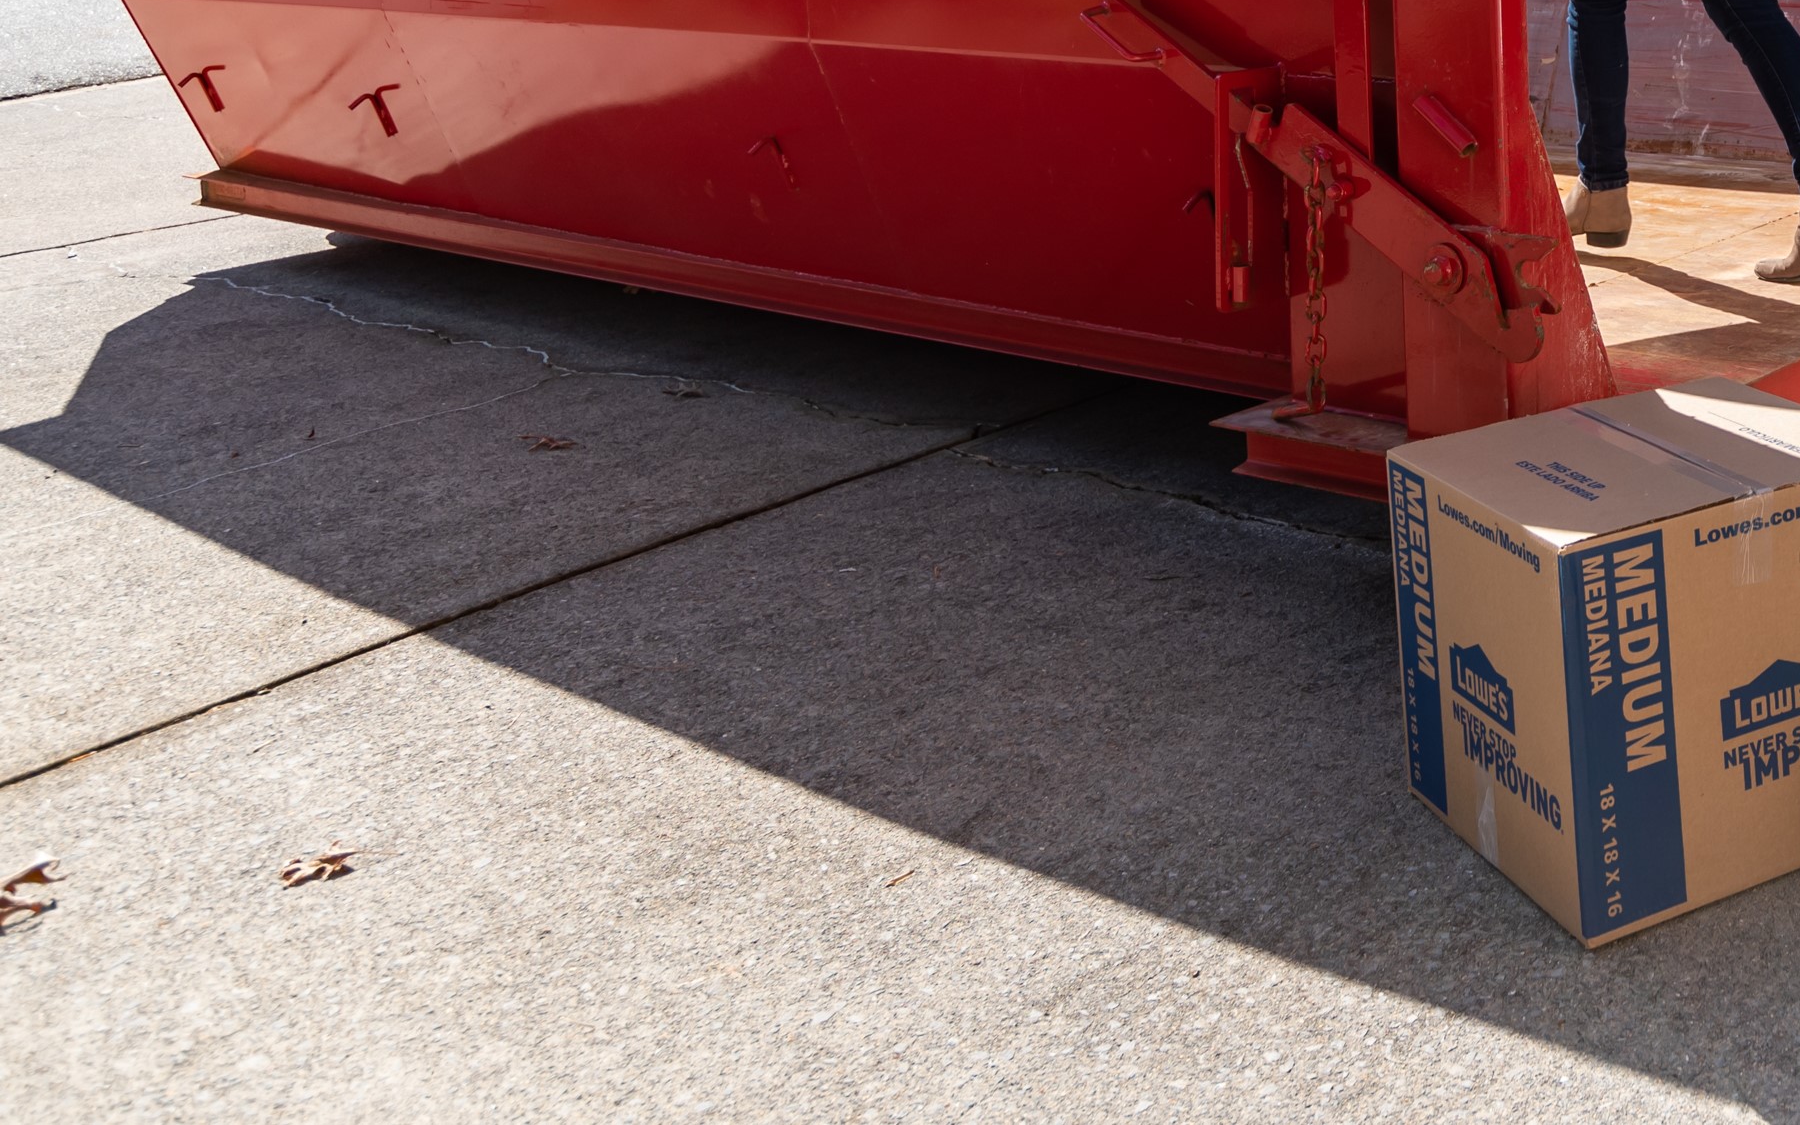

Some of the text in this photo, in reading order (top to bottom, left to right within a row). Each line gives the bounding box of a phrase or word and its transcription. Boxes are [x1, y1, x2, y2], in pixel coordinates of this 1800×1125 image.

[1515, 460, 1599, 501] ESTE LADO ARRIBA
[1546, 461, 1571, 473] THIS
[1565, 471, 1593, 483] SIDE
[1392, 469, 1410, 586] MEDIANA
[1404, 477, 1436, 681] MEDIUM
[1436, 494, 1541, 574] Lowes.com/Moving
[1581, 554, 1613, 697] MEDIANA
[1612, 541, 1668, 773] MEDIUM
[1407, 667, 1422, 782] 18 X 18 X 16
[1453, 700, 1517, 760] NEVER STOP
[1456, 655, 1509, 721] LOWE'S
[1460, 722, 1562, 830] IMPROVING
[1723, 731, 1787, 769] NEVER
[1598, 783, 1624, 921] 18 X 18 X 16
